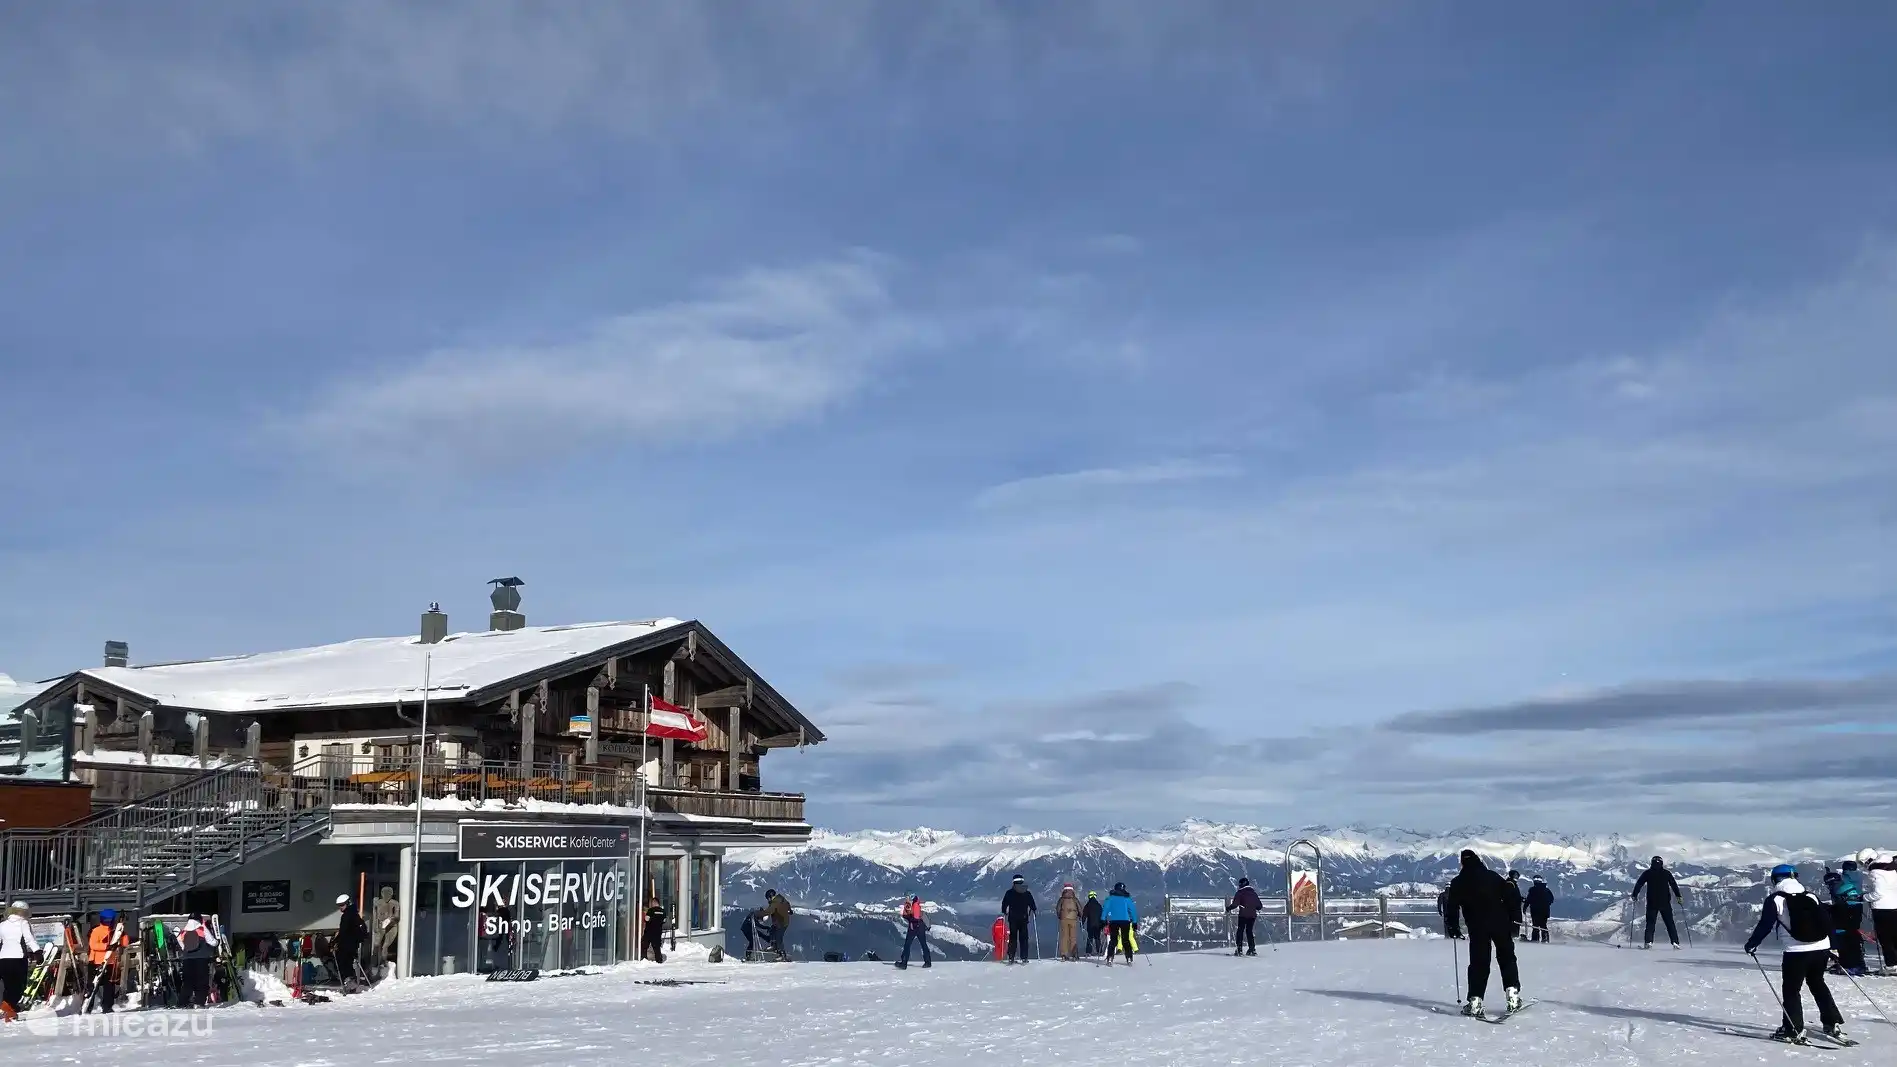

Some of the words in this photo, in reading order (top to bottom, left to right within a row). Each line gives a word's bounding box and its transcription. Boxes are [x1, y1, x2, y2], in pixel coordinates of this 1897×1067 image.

[495, 836, 567, 849] SKISERVICE
[569, 835, 616, 848] KofelCenter
[451, 871, 626, 908] SKISERVICE
[484, 916, 532, 937] Shop
[490, 970, 532, 980] BURTON
